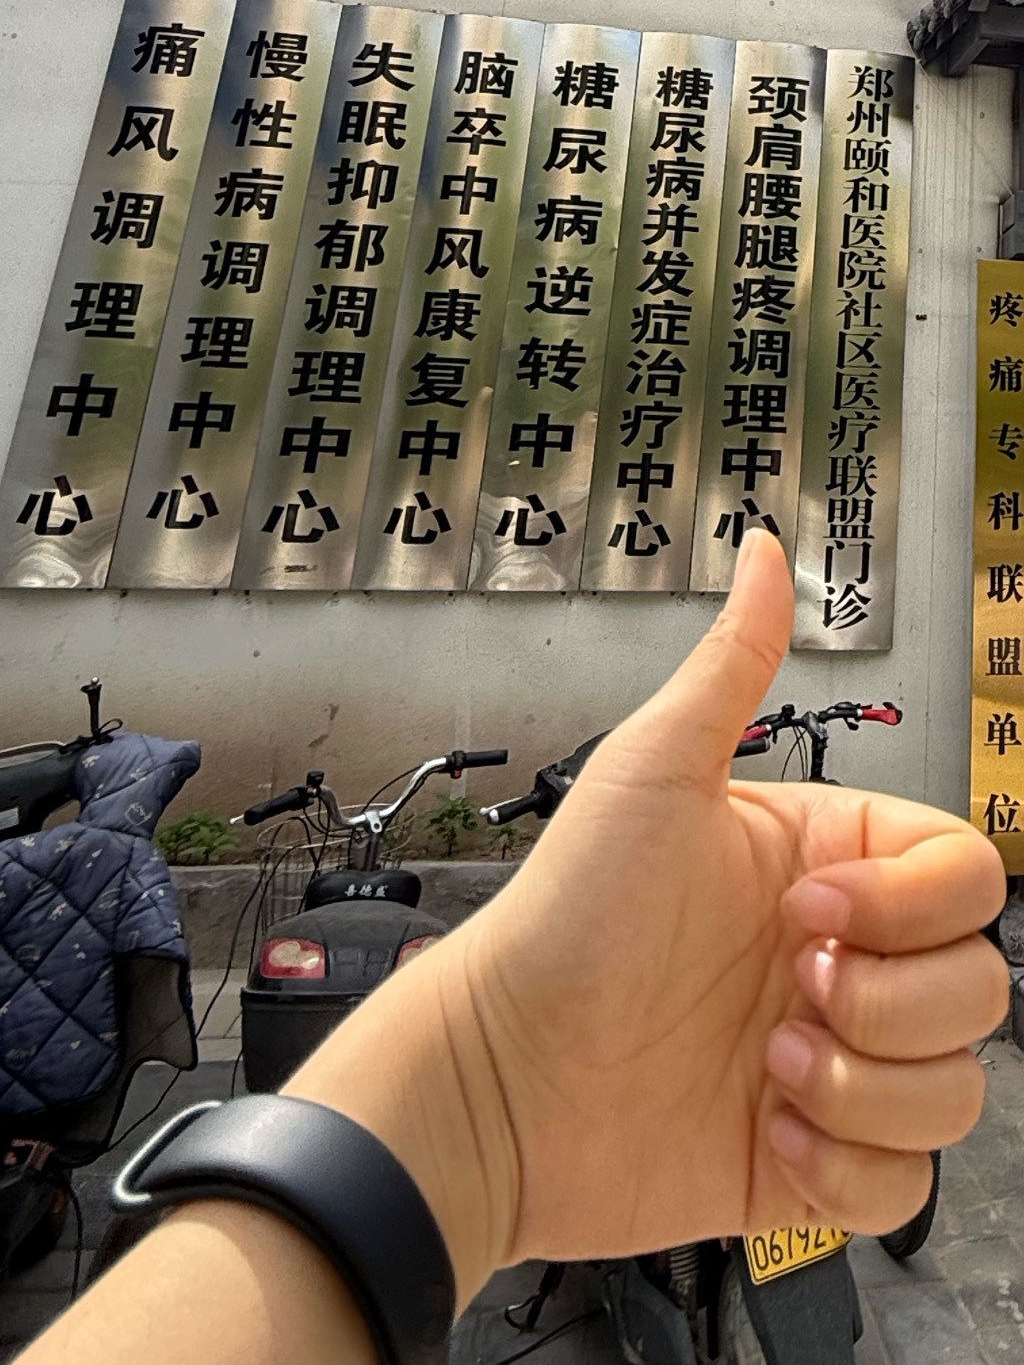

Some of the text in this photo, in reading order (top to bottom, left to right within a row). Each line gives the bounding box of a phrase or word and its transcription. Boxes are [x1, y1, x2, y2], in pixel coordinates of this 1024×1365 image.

[16, 23, 205, 536] 痛风调理中心
[146, 30, 309, 530] 慢性病调理中心
[261, 42, 416, 544] 失眠抑郁调理中心
[383, 51, 518, 545] 脑卒中风康复中心
[494, 60, 620, 547] 糖尿病逆转中心
[607, 66, 714, 557] 糖尿病并发症治疗中心
[713, 75, 811, 549] 颈肩腰腿疼调理中心
[819, 65, 895, 631] 郑州颐和医院社区医疗联盟门诊
[983, 292, 1024, 836] 疼痛专科联盟单位
